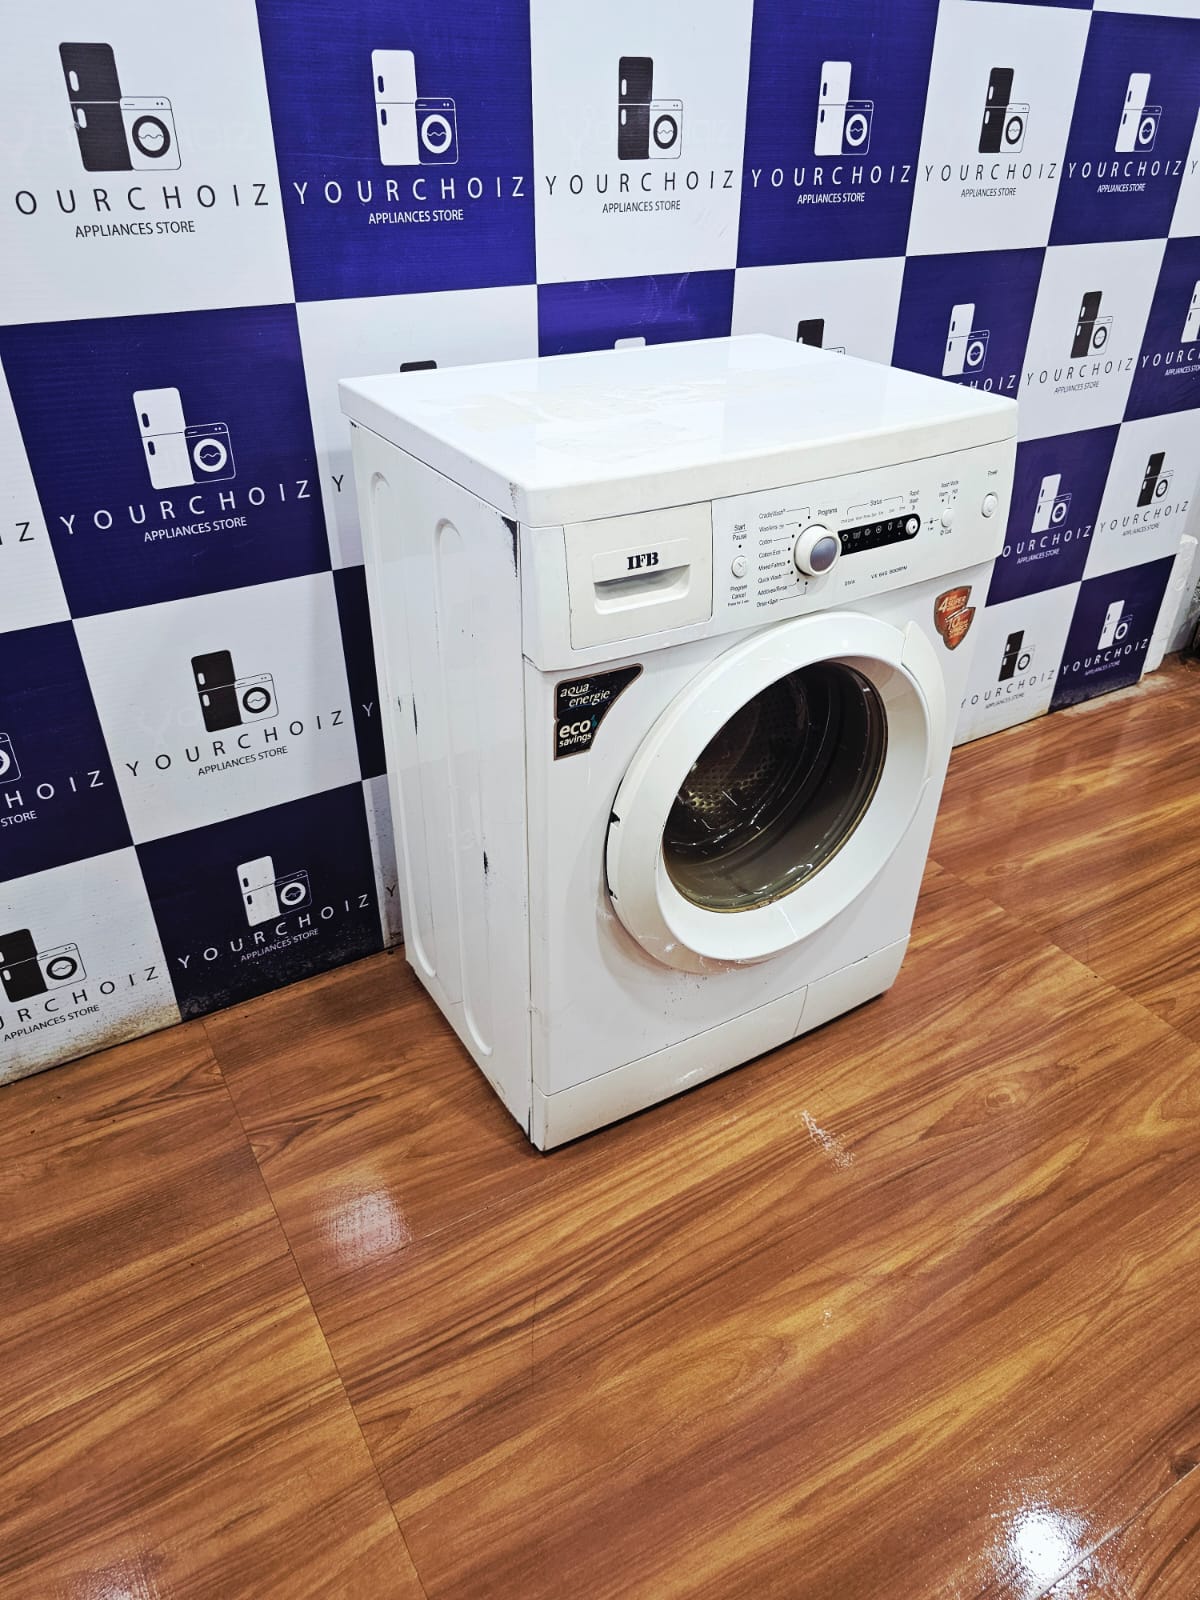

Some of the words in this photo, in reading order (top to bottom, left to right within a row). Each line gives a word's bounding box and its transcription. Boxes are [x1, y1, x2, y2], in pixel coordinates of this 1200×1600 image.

[752, 165, 912, 188] YOURCHOIZ
[923, 163, 1058, 182] YOURCHOIZ
[1068, 160, 1182, 179] YOURCHOIZ
[293, 176, 525, 206] YOURCHOIZ
[545, 170, 734, 196] YOURCHOIZ
[960, 188, 997, 198] APPLIANCES
[998, 187, 1017, 197] STORE
[1097, 184, 1129, 193] APPLIANCES
[1130, 183, 1146, 192] STORE
[15, 183, 269, 215] OURCHOIZ
[602, 201, 654, 213] APPLIANCES
[655, 200, 681, 211] STORE
[797, 193, 841, 205] APPLIANCES
[842, 192, 865, 203] STORE
[368, 210, 431, 225] APPLIANCES
[433, 208, 464, 223] STORE
[75, 222, 154, 238] APPLIANCES
[156, 220, 196, 234] STORE
[1142, 348, 1200, 369] YOURC
[1027, 358, 1133, 386] YOURCHOIZ
[60, 480, 311, 535] YOURCHOIZ
[144, 521, 212, 543] APPLIANCES
[213, 516, 248, 532] STORE
[734, 523, 746, 532] Start
[1002, 525, 1092, 558] OURCHOIZ
[627, 552, 659, 570] IFB
[732, 592, 746, 600] Cancel
[560, 683, 591, 698] aqua
[569, 689, 611, 707] energie
[559, 719, 591, 738] eco
[125, 710, 345, 778] YOURCHOIZ
[559, 732, 592, 748] savings
[198, 754, 257, 776] APPLIANCES
[257, 745, 288, 763] STORE
[0, 810, 38, 827] STORE
[177, 894, 370, 970] YOURCHOIZ
[240, 936, 292, 963] APPLIANCES
[290, 928, 319, 946] STORE
[4, 1014, 66, 1042] APPLIANCES
[68, 1004, 100, 1021] STORE
